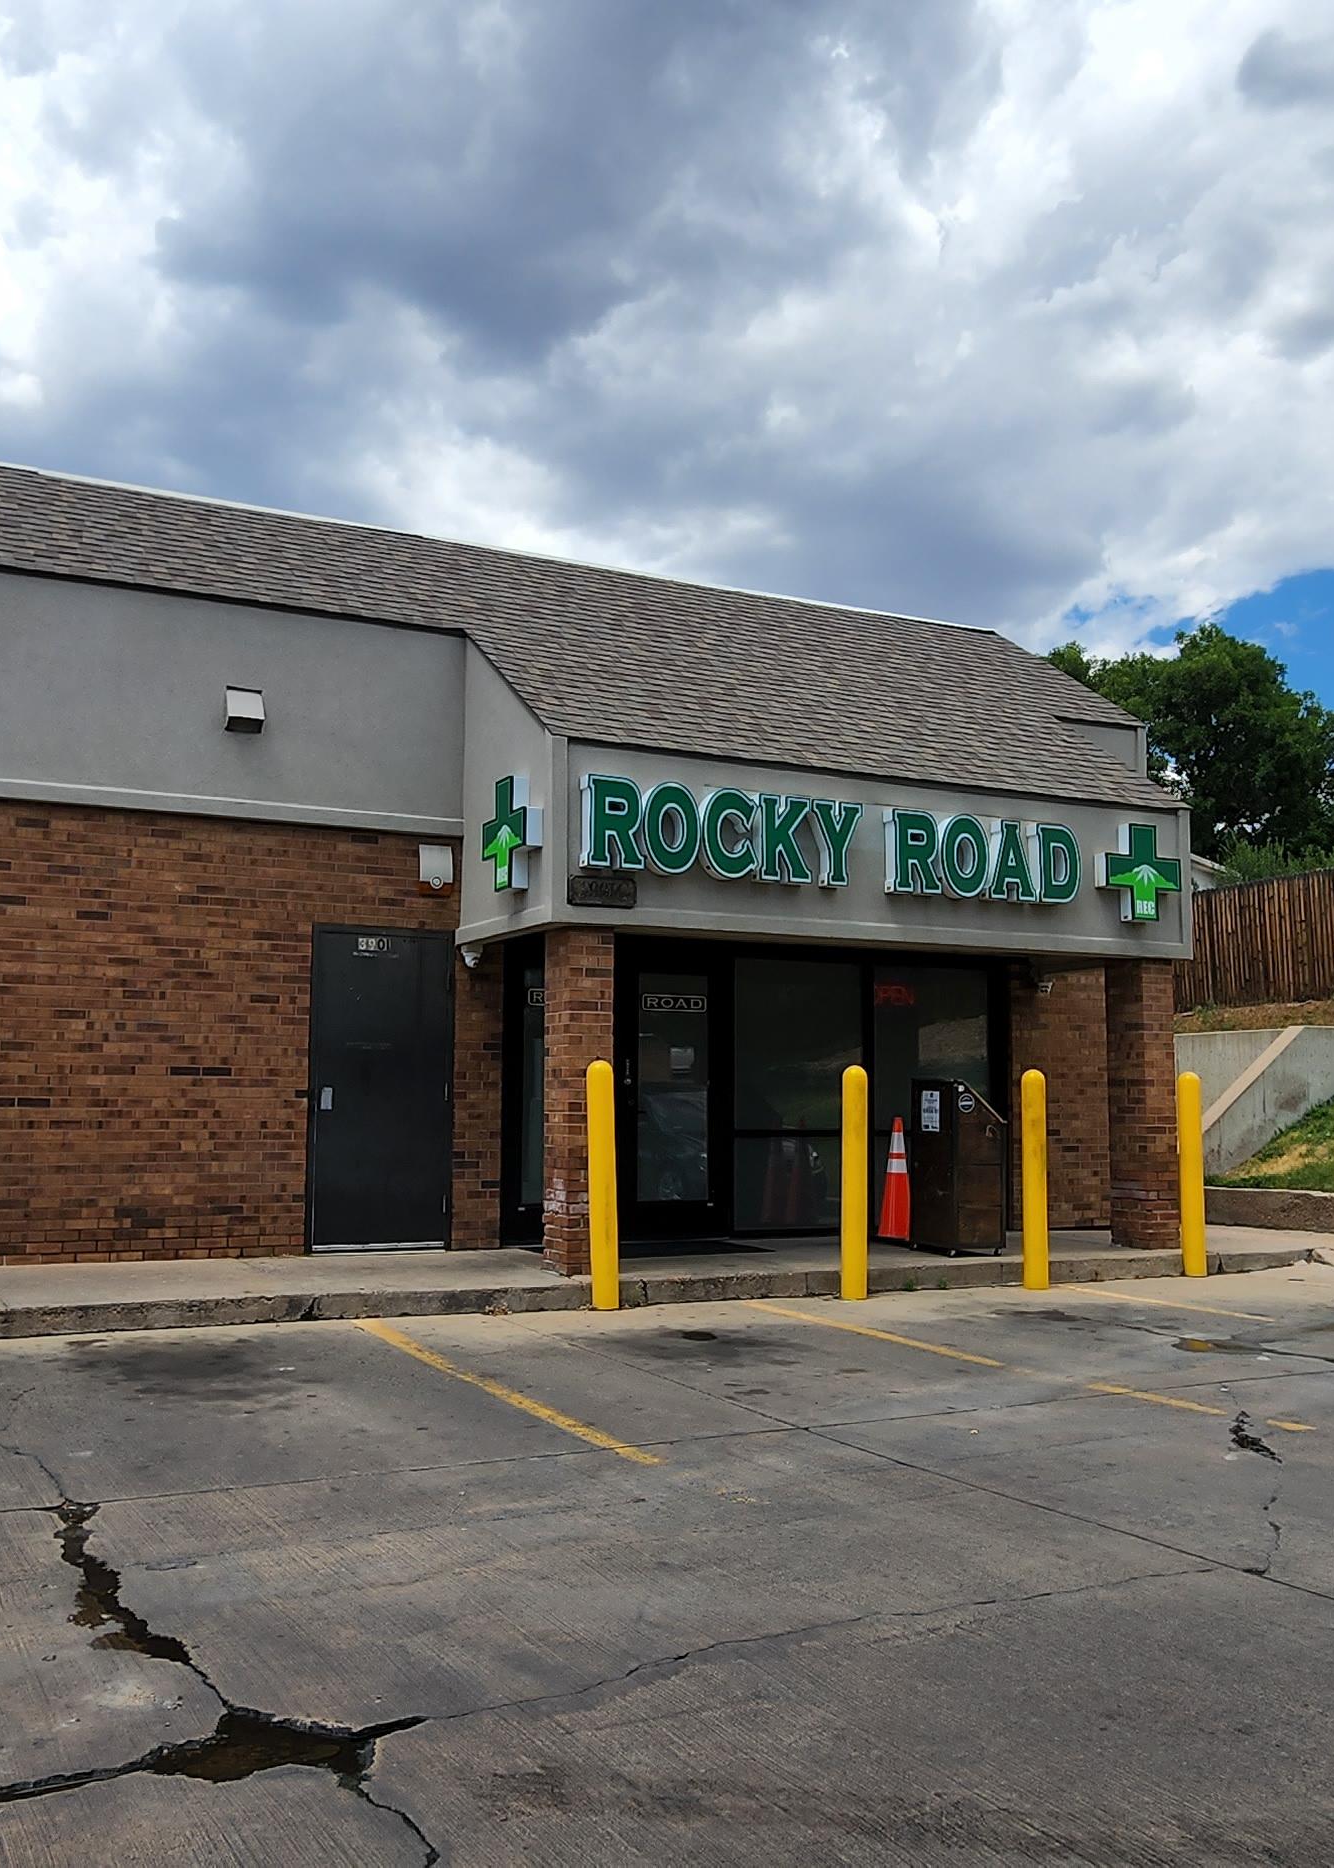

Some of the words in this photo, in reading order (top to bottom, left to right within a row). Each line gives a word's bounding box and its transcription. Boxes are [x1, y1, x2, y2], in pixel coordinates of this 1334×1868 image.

[581, 773, 864, 888] ROCKY
[884, 808, 1082, 904] ROAD
[1136, 899, 1156, 915] REC
[646, 996, 703, 1010] ROAD
